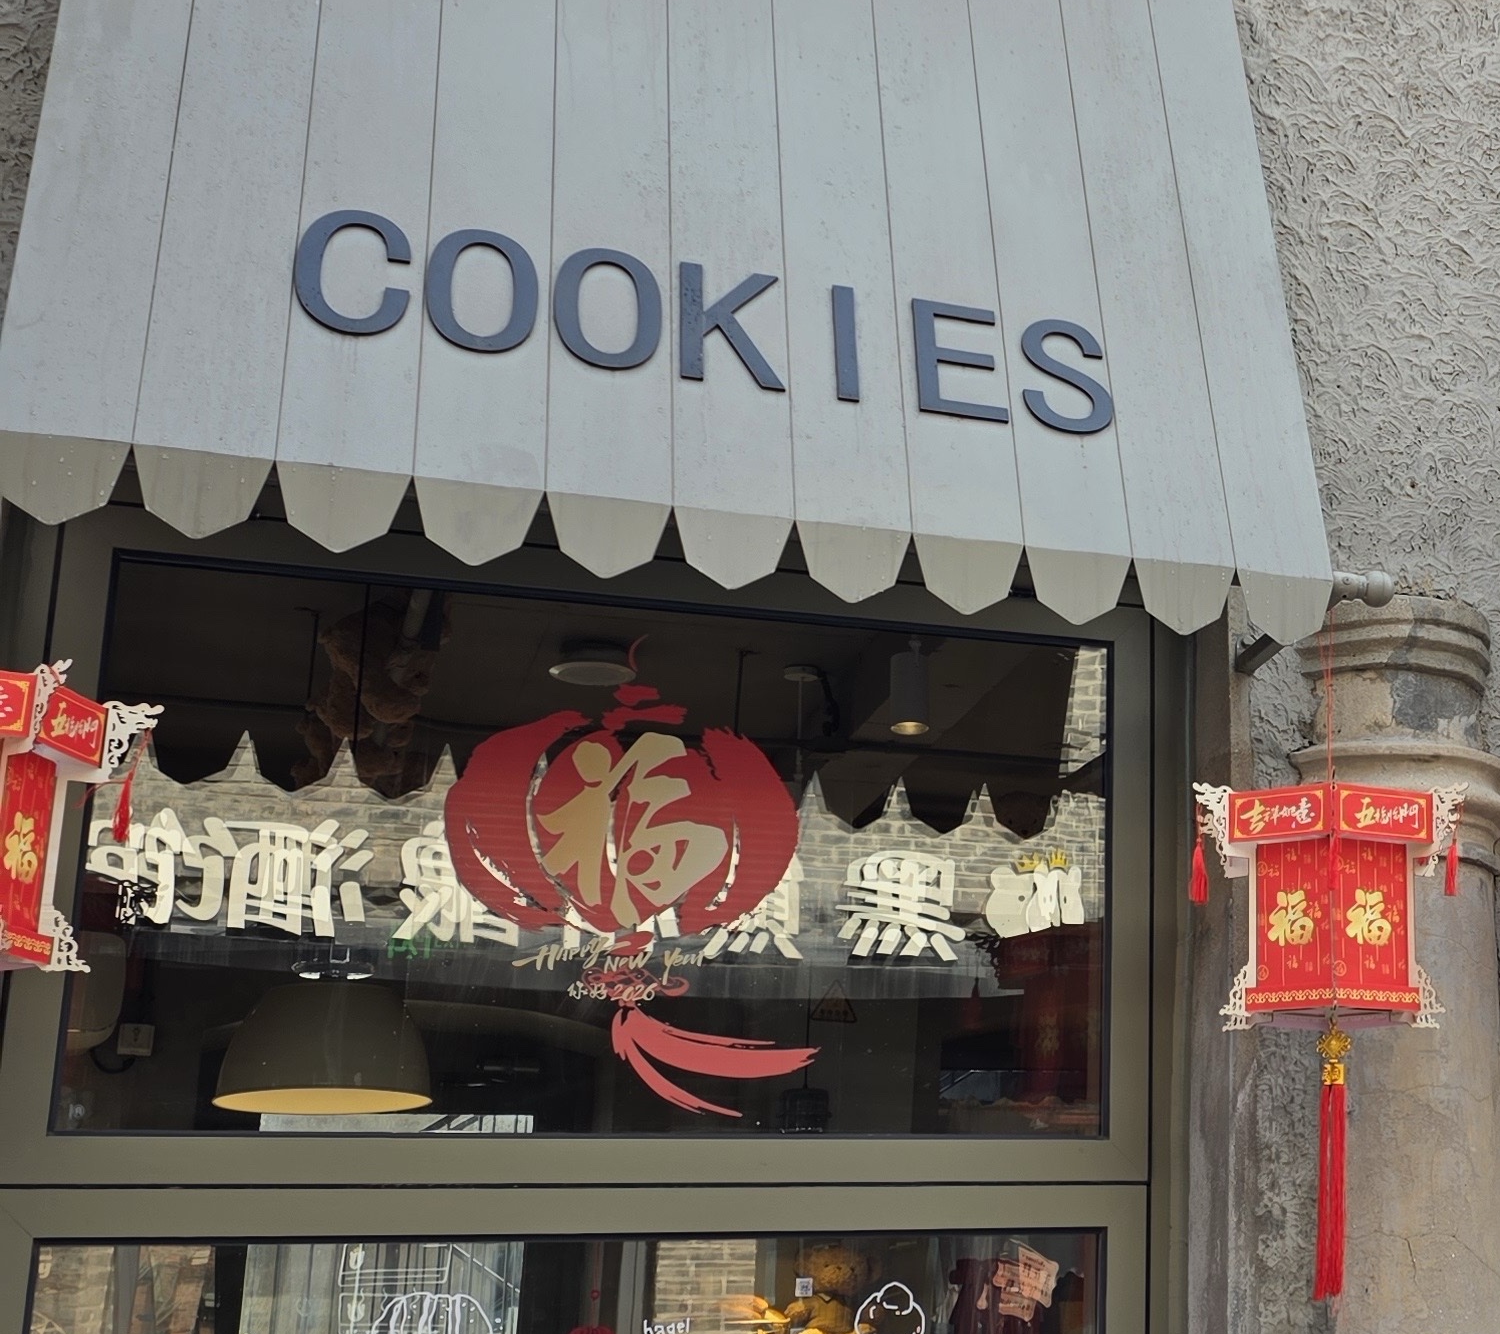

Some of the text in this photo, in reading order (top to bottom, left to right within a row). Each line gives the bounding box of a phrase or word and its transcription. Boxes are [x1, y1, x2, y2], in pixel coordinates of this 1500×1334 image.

[293, 209, 1113, 435] COOKIES
[537, 732, 728, 930] 福
[1267, 889, 1313, 946] 福
[1345, 888, 1392, 946] 福
[610, 982, 659, 1001] 2026
